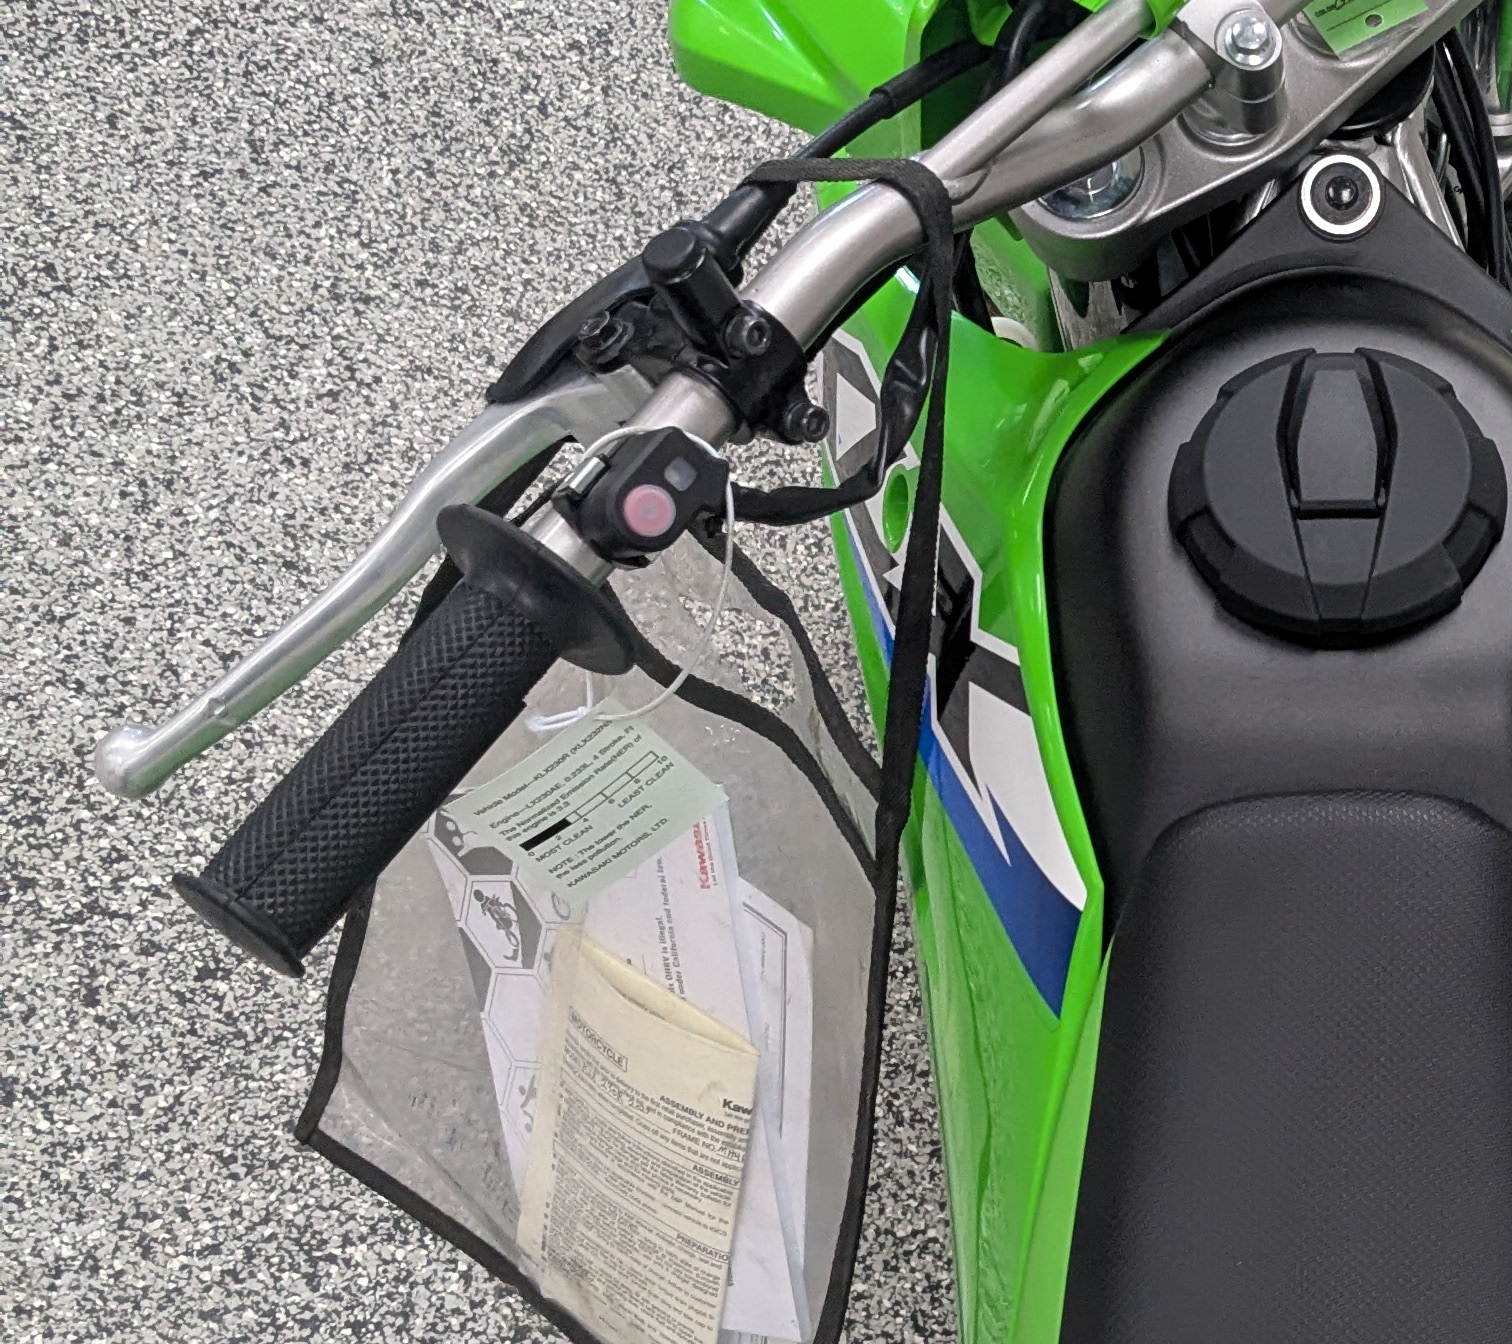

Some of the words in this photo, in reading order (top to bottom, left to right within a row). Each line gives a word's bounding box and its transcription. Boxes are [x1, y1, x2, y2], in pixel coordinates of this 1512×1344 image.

[499, 827, 517, 836] The
[516, 798, 561, 827] Normalized
[560, 775, 595, 800] Emission
[634, 734, 643, 743] of
[618, 785, 645, 808] LEAST
[645, 761, 675, 786] CLEAN
[473, 798, 503, 816] Vehicle
[505, 832, 522, 841] this
[522, 816, 548, 833] engine
[556, 801, 571, 812] 3.3
[535, 844, 562, 862] MOST
[562, 824, 593, 846] CLEAN
[548, 857, 575, 874] NOTE
[578, 844, 595, 855] The
[594, 829, 616, 845] lower
[616, 819, 631, 830] the
[555, 869, 571, 879] the
[569, 859, 588, 871] less
[587, 837, 623, 861] pollution.
[567, 858, 613, 888] KAWASAKI
[656, 856, 666, 874] law.
[660, 875, 671, 906] federal
[656, 915, 667, 944] illegal.
[666, 908, 675, 924] and
[668, 924, 681, 968] California
[675, 971, 685, 995] under
[571, 1012, 624, 1068] MOTORCYCLE
[660, 1095, 705, 1120] ASSEMBLY
[705, 1116, 725, 1128] AND
[672, 1127, 700, 1146] FRAME
[692, 1164, 740, 1187] ASSEMBLY
